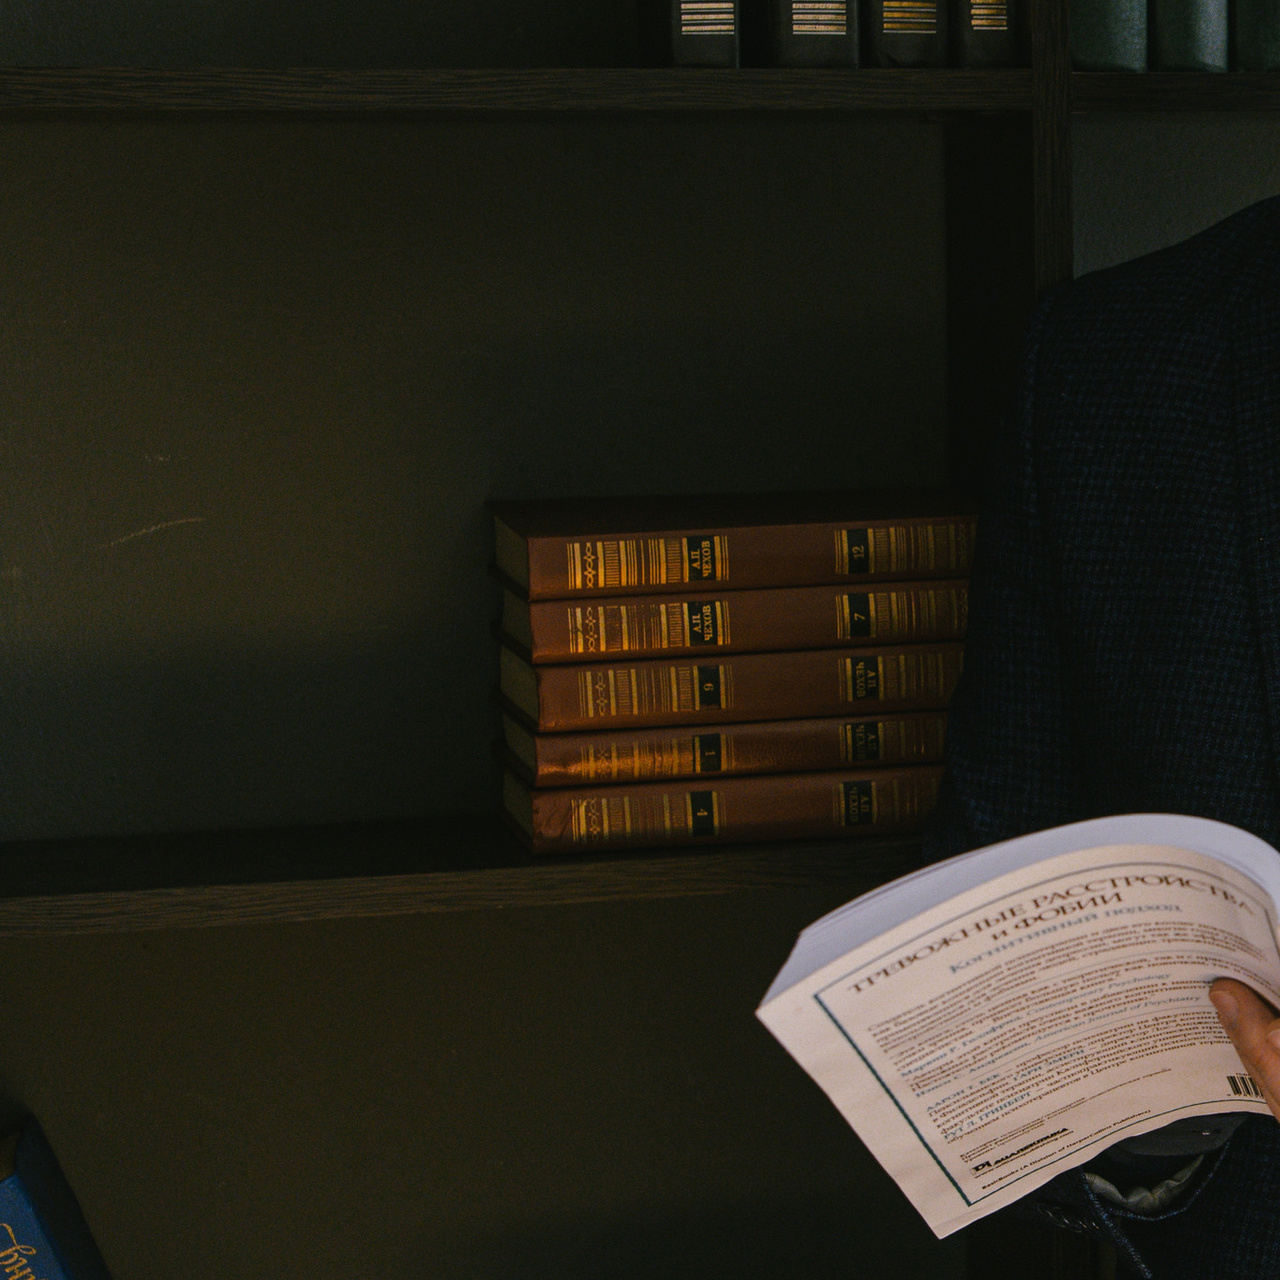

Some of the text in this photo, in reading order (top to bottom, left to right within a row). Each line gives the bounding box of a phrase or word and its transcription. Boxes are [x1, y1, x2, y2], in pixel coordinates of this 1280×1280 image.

[701, 540, 711, 578] ЧЕХОВ
[852, 544, 864, 560] 12
[702, 604, 712, 642] ЧЕХОВ
[854, 612, 865, 622] 7
[703, 682, 714, 691] 6
[697, 808, 708, 817] 4
[1015, 892, 1122, 929] ФОБИИ
[849, 873, 1255, 993] ТРЕВОЖНЫЕ РАССТРОЙСТВА
[950, 913, 1098, 973] Когнитивный
